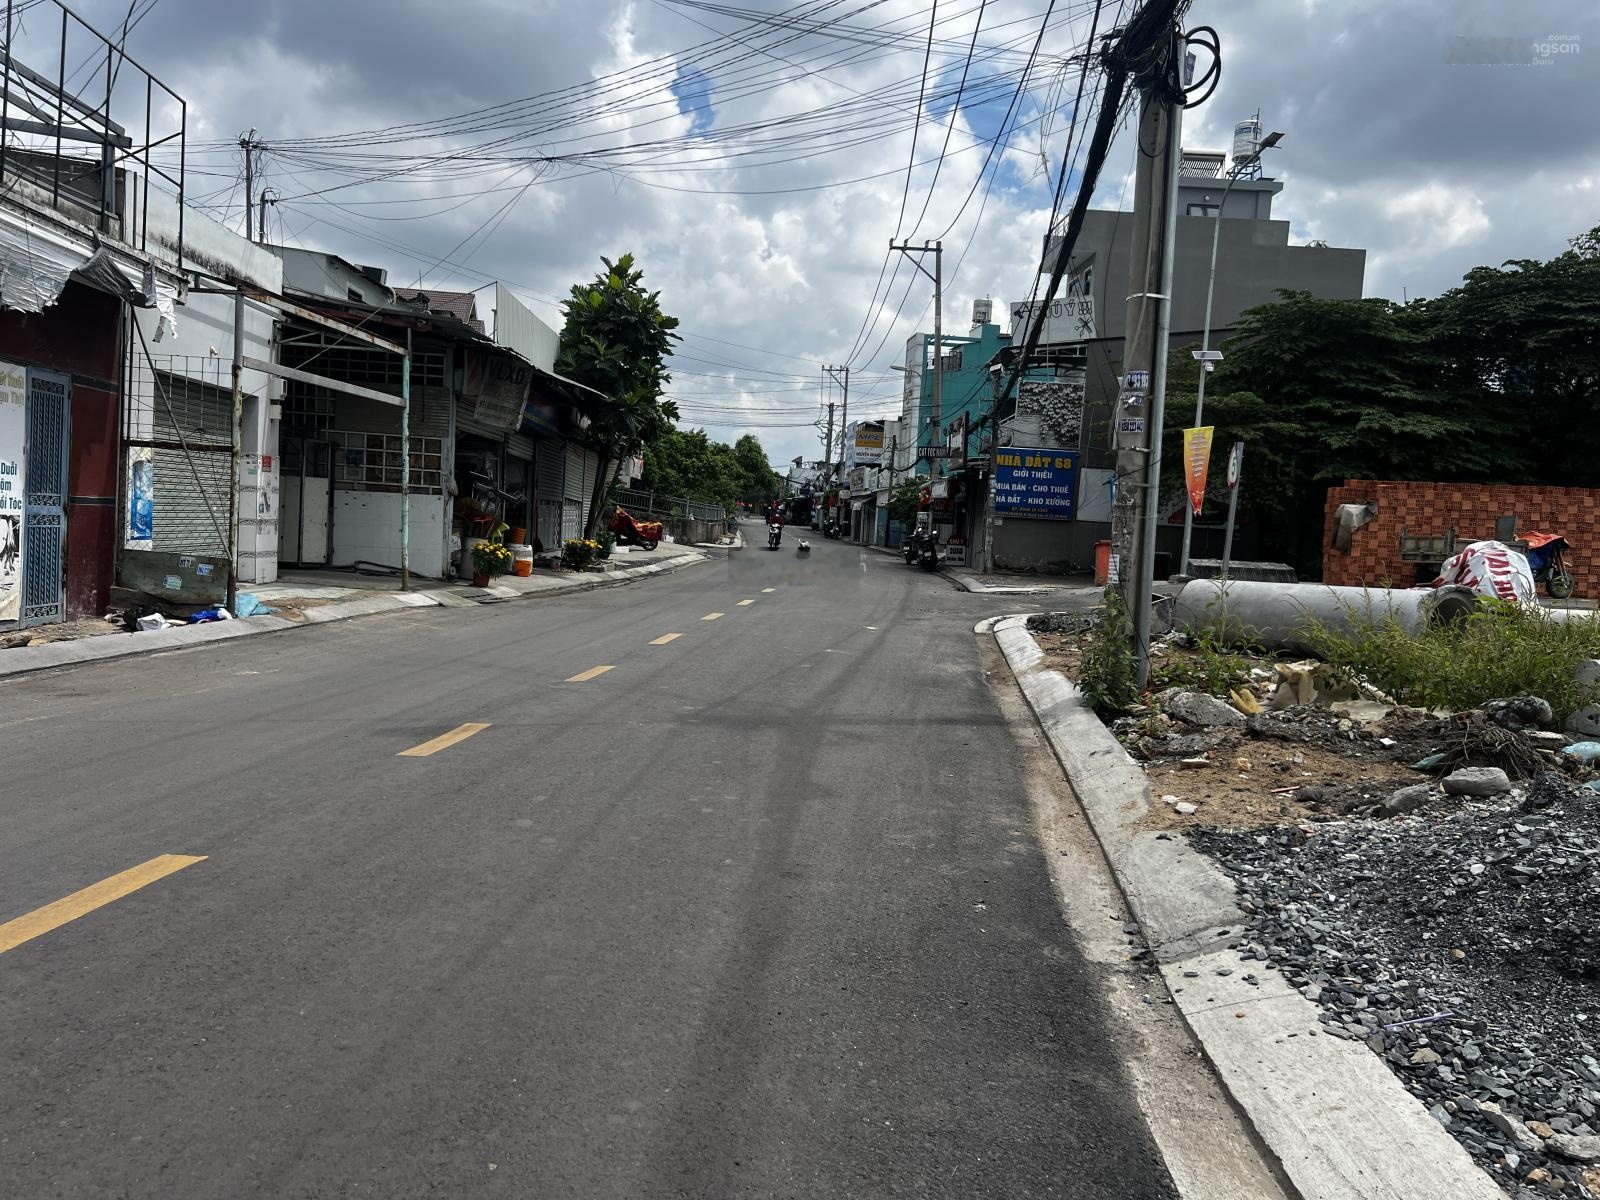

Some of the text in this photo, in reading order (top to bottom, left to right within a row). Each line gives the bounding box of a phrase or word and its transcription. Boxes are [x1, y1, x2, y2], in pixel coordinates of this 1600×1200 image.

[996, 452, 1021, 467] NHÀ
[1054, 457, 1072, 469] 68
[996, 483, 1010, 491] MUA
[1011, 481, 1026, 491] BÁN
[1032, 484, 1048, 493] CHO
[9, 495, 22, 510] Tóc
